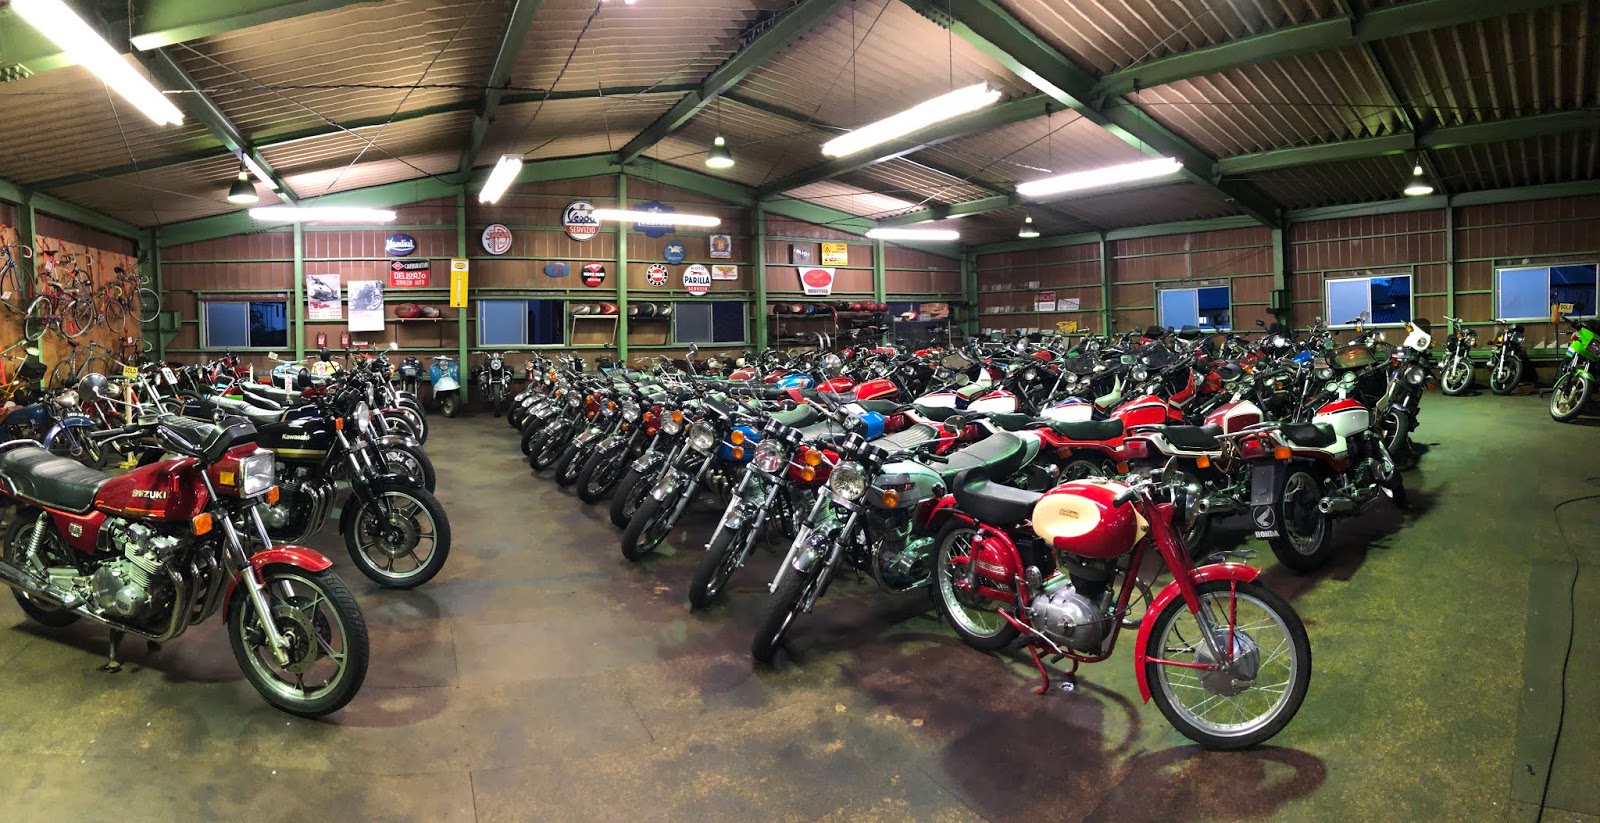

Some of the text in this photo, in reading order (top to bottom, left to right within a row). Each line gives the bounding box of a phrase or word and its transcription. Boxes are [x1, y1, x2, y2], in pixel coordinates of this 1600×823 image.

[566, 206, 598, 225] Vespa
[570, 226, 596, 235] SERVIZIO
[685, 276, 710, 284] PARILLA
[282, 432, 311, 441] Kawasaki
[132, 489, 167, 499] SUZUKI
[1254, 530, 1280, 538] HONDA
